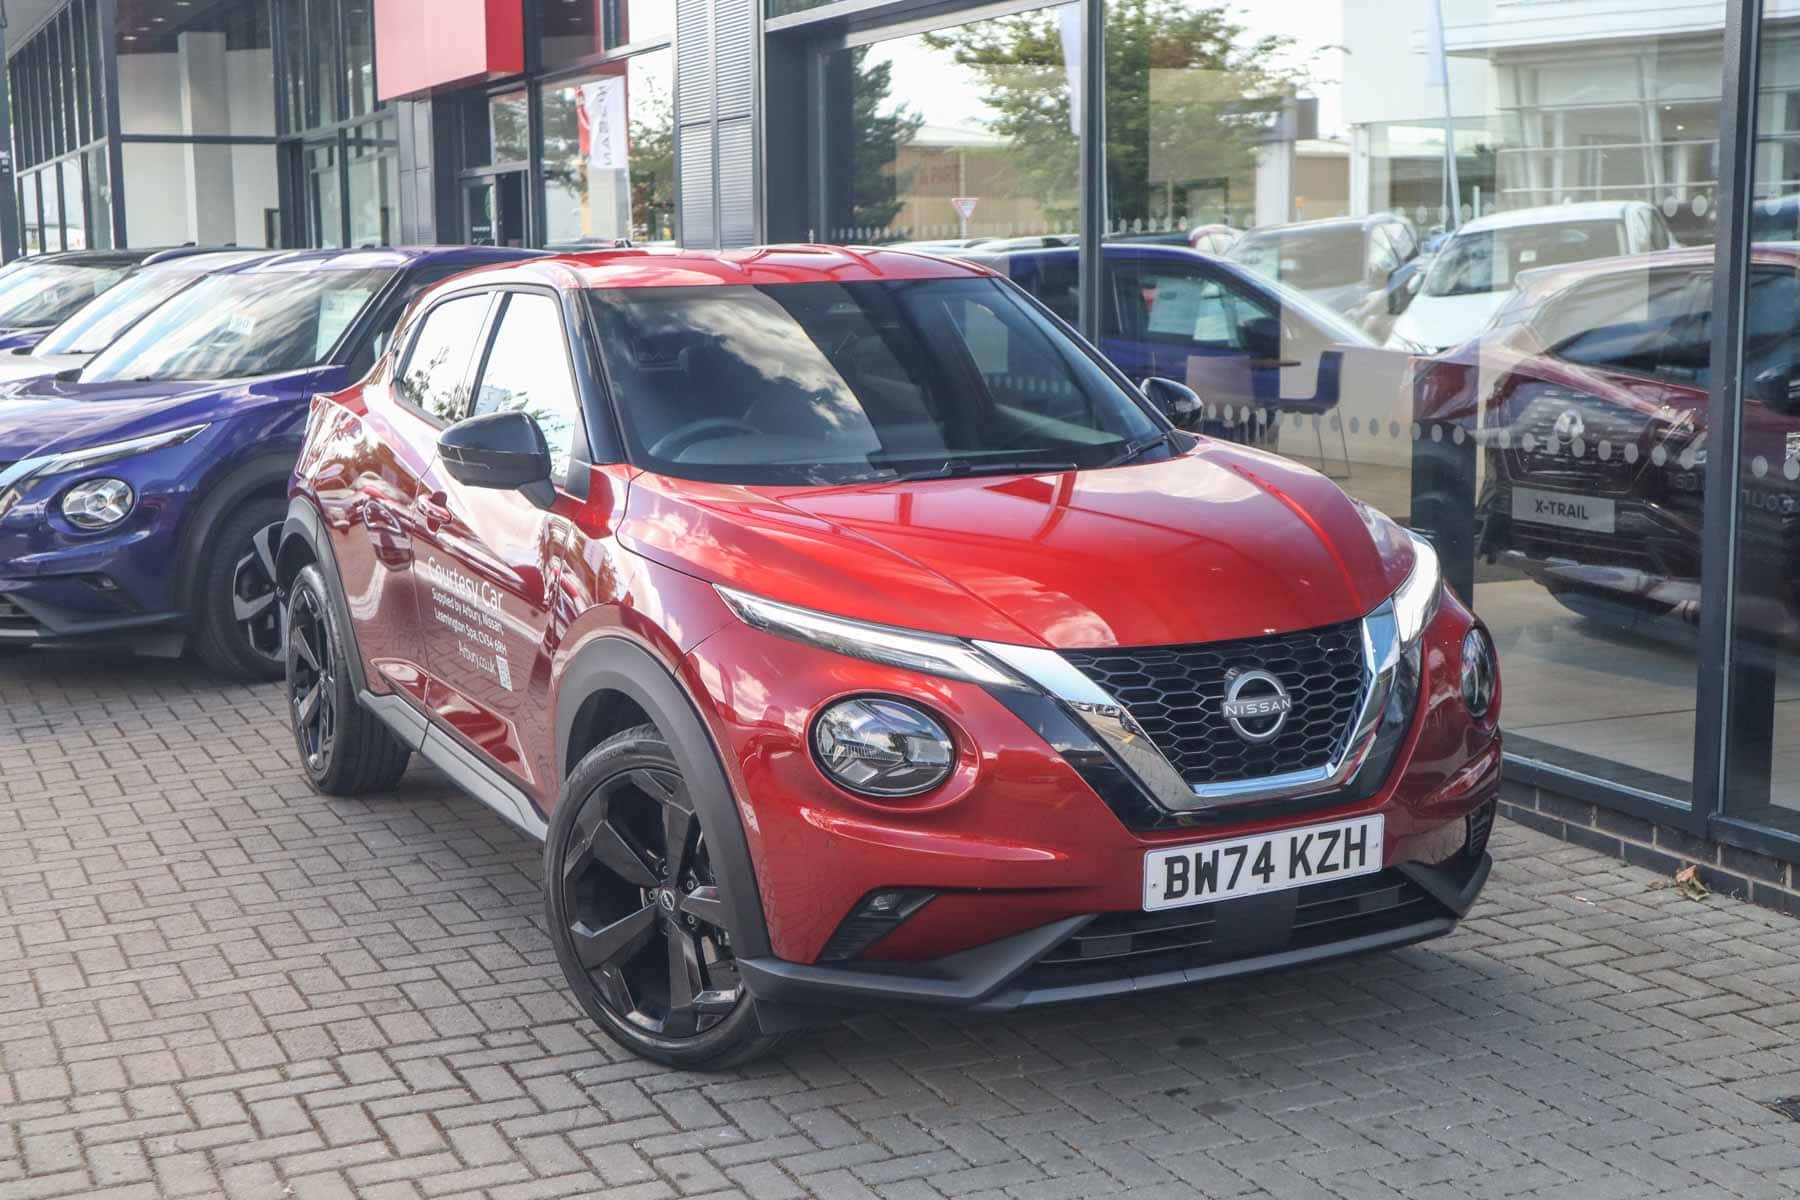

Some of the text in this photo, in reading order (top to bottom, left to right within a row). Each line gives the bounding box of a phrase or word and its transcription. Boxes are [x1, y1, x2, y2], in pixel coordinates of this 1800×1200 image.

[1535, 499, 1589, 520] X-TRAIL
[428, 556, 503, 611] Courtesy Car
[478, 631, 494, 649] CV34
[1224, 697, 1291, 716] NISSAN
[1163, 824, 1368, 900] BW74 KZH
